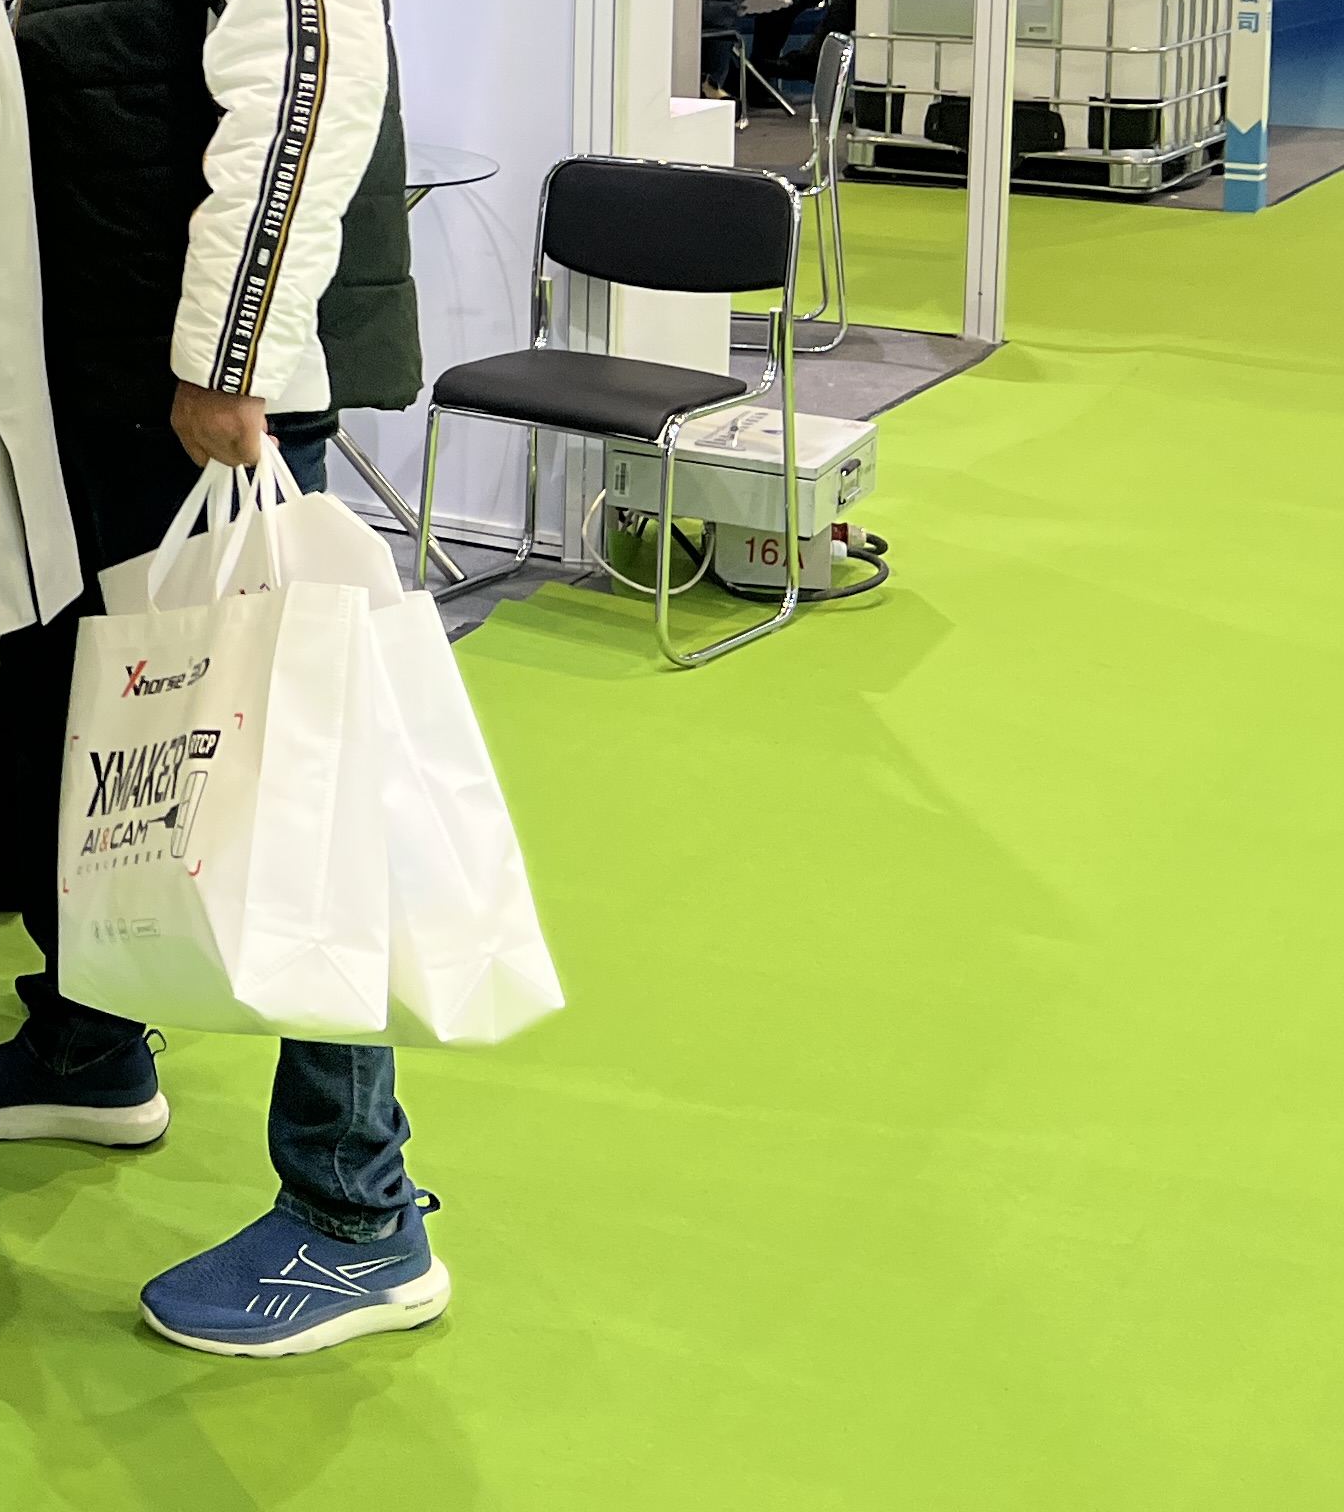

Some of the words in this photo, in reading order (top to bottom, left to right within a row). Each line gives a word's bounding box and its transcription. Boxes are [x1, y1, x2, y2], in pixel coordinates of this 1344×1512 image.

[289, 71, 317, 141] BELIEVE
[282, 139, 301, 158] IN
[262, 157, 298, 239] YOURSELF
[235, 275, 266, 339] BELIEVE
[230, 342, 248, 362] IN
[121, 660, 185, 697] Xhorse
[86, 734, 186, 818] XMAKER
[81, 819, 148, 857] AI&CAM
